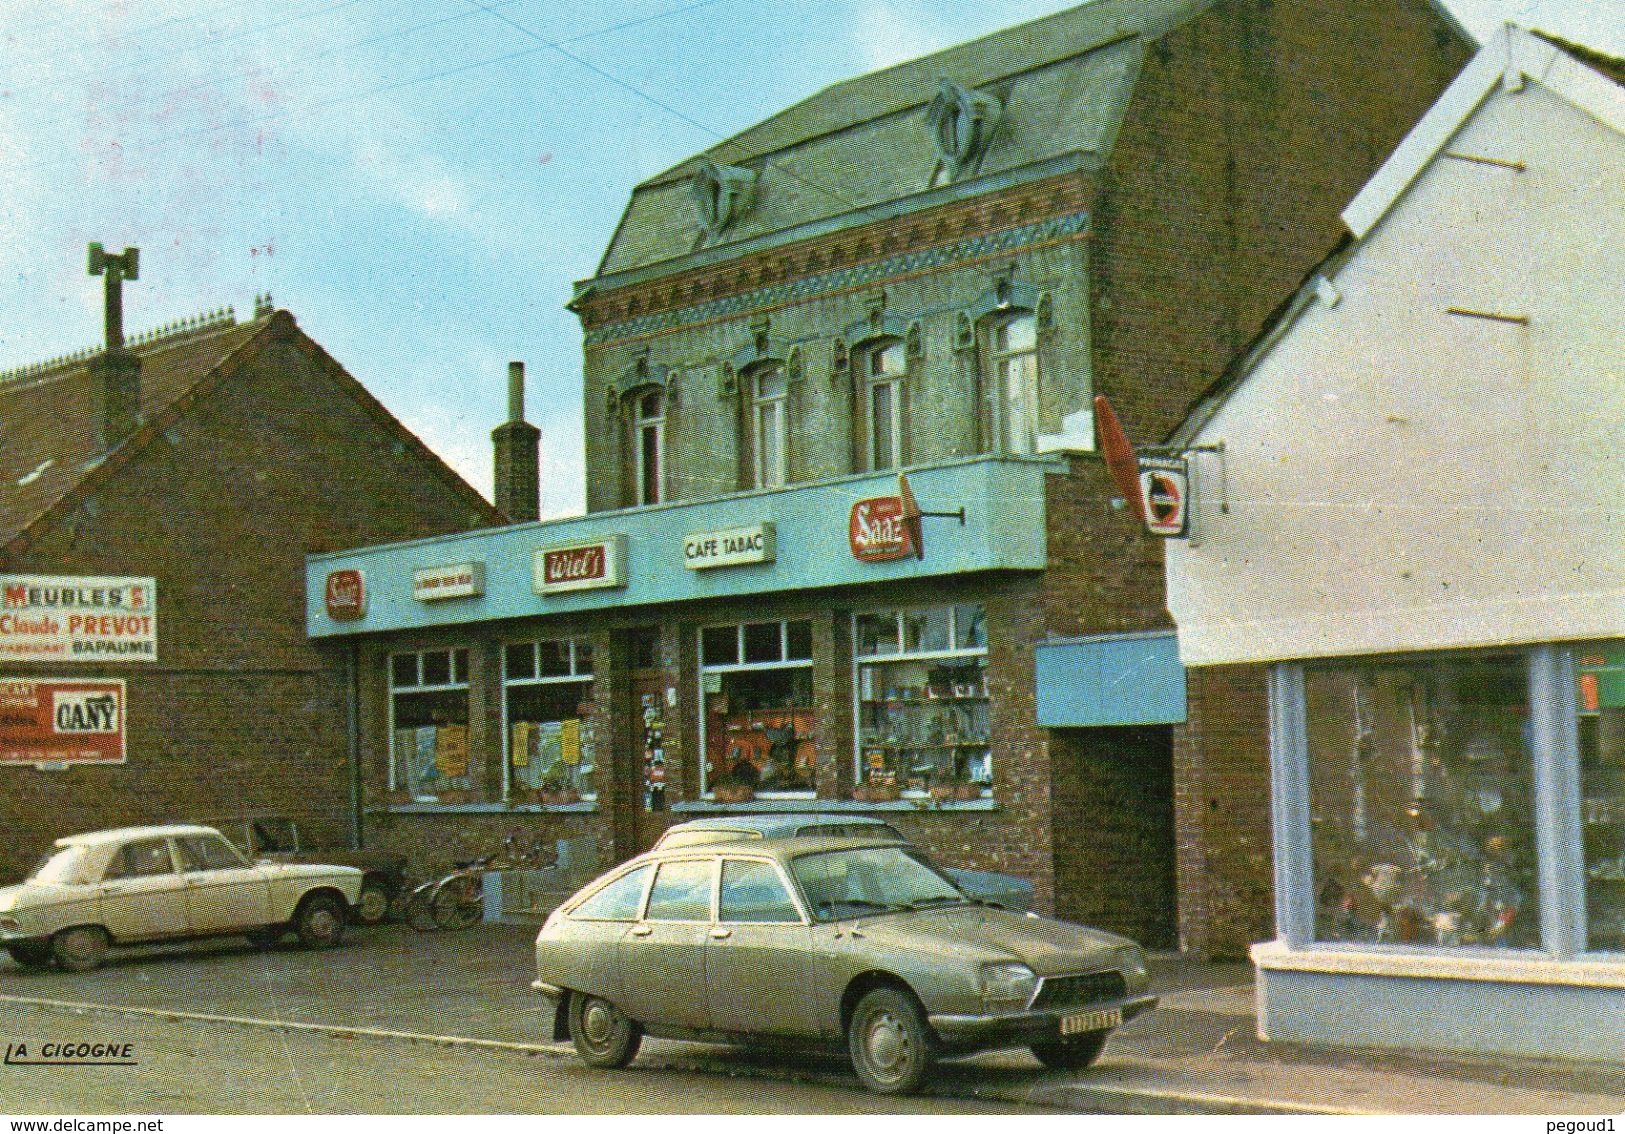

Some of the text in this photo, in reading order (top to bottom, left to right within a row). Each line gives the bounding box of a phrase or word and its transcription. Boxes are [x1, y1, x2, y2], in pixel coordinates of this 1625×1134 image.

[851, 503, 904, 546] Saaz
[685, 534, 763, 559] CAFE TABAC
[4, 585, 123, 608] MEUBLES
[0, 614, 151, 635] Claude PREVOT
[72, 640, 153, 654] BAPAUME
[57, 703, 116, 730] CANY
